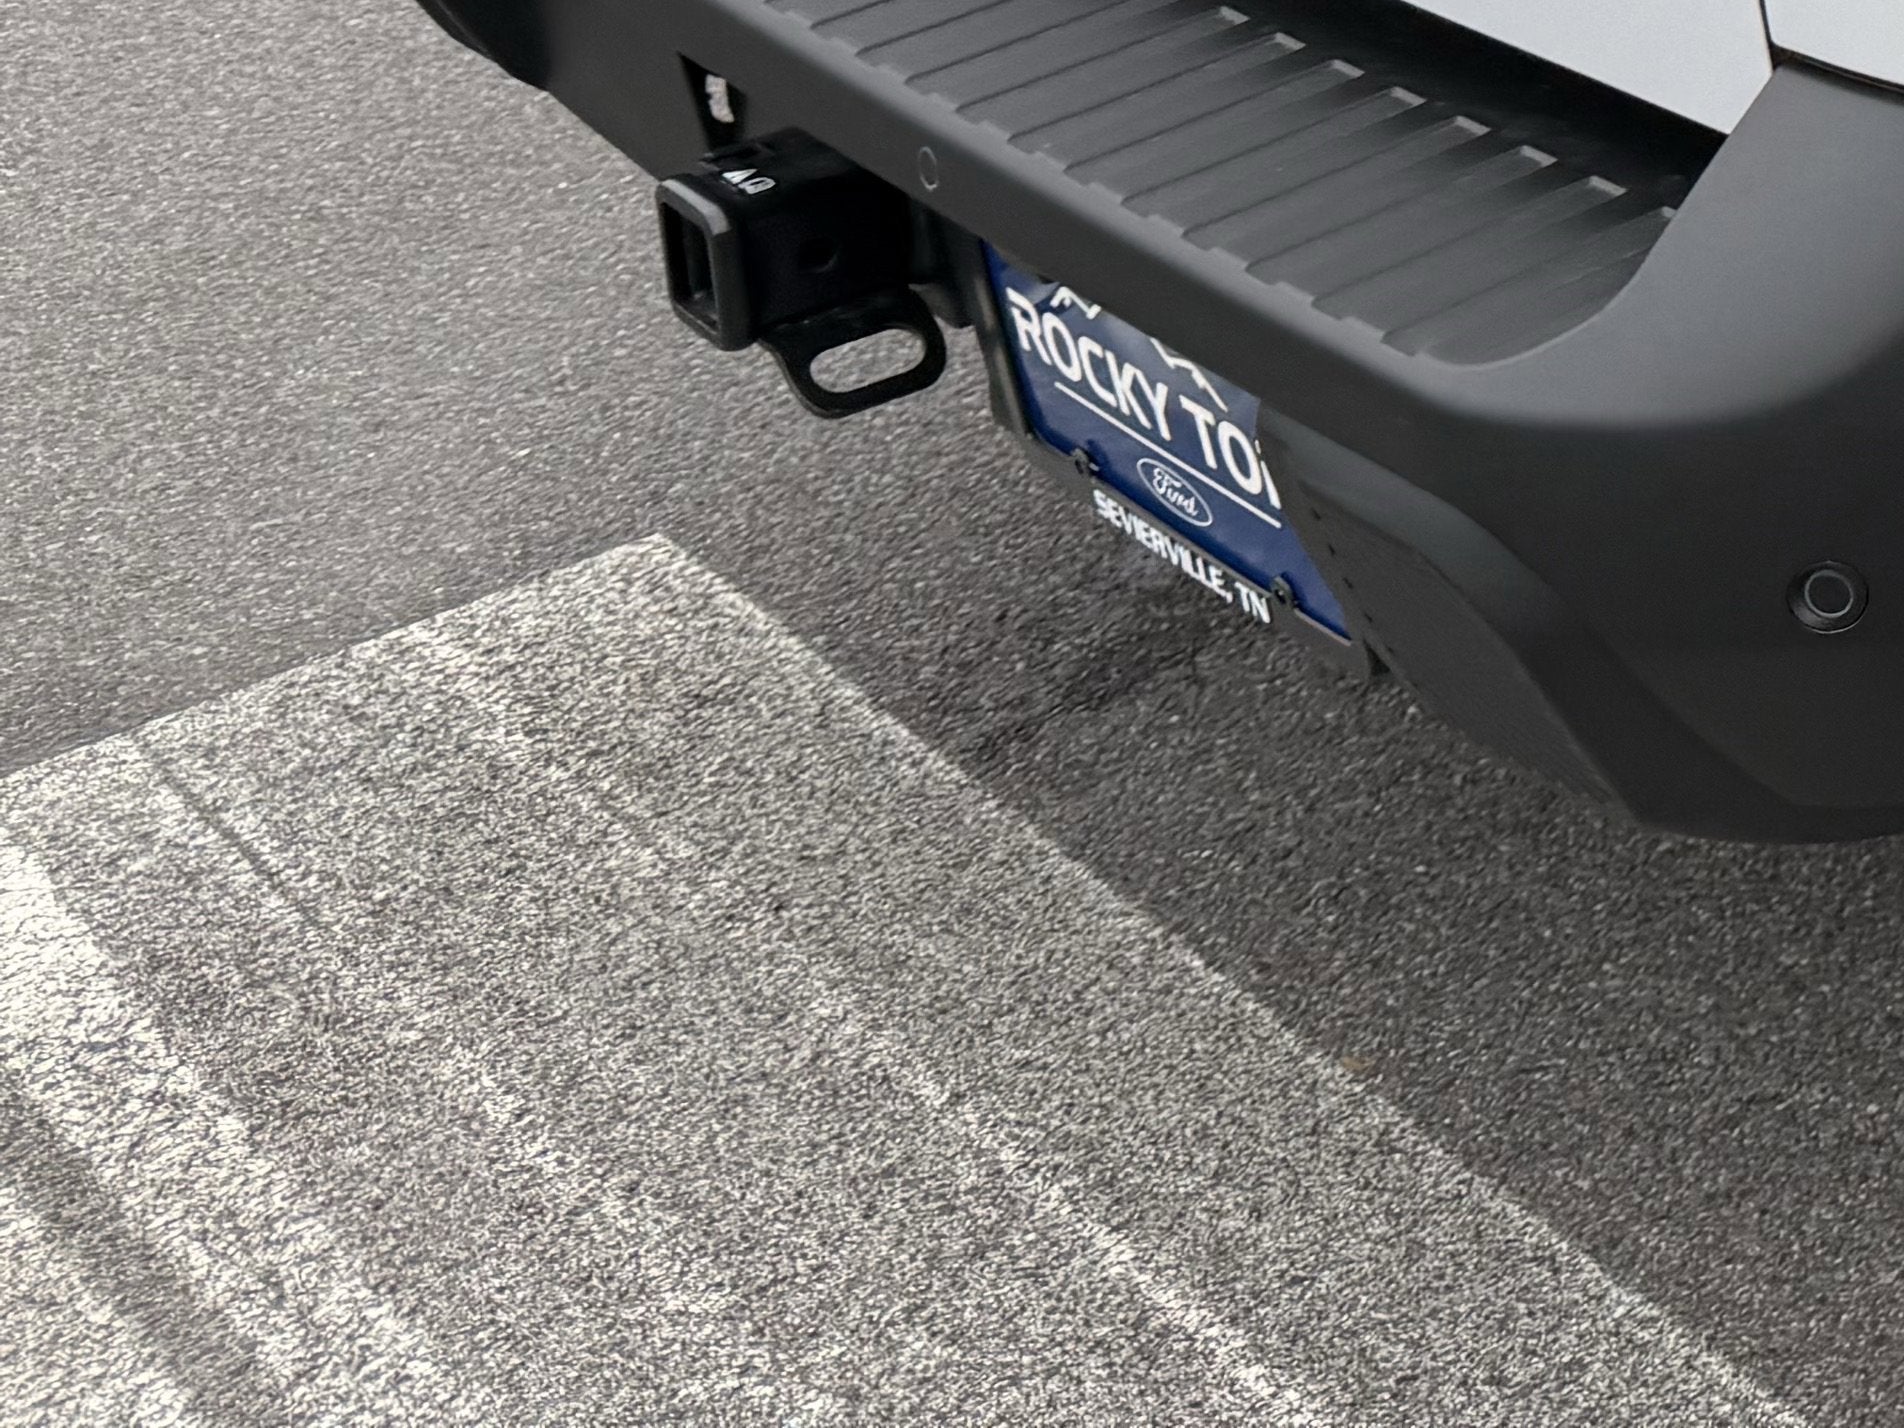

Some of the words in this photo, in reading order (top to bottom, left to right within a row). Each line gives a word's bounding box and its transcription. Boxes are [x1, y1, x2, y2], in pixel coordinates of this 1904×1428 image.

[1005, 286, 1172, 442] ROCKY
[1152, 465, 1199, 517] Ford
[1235, 581, 1272, 624] TN
